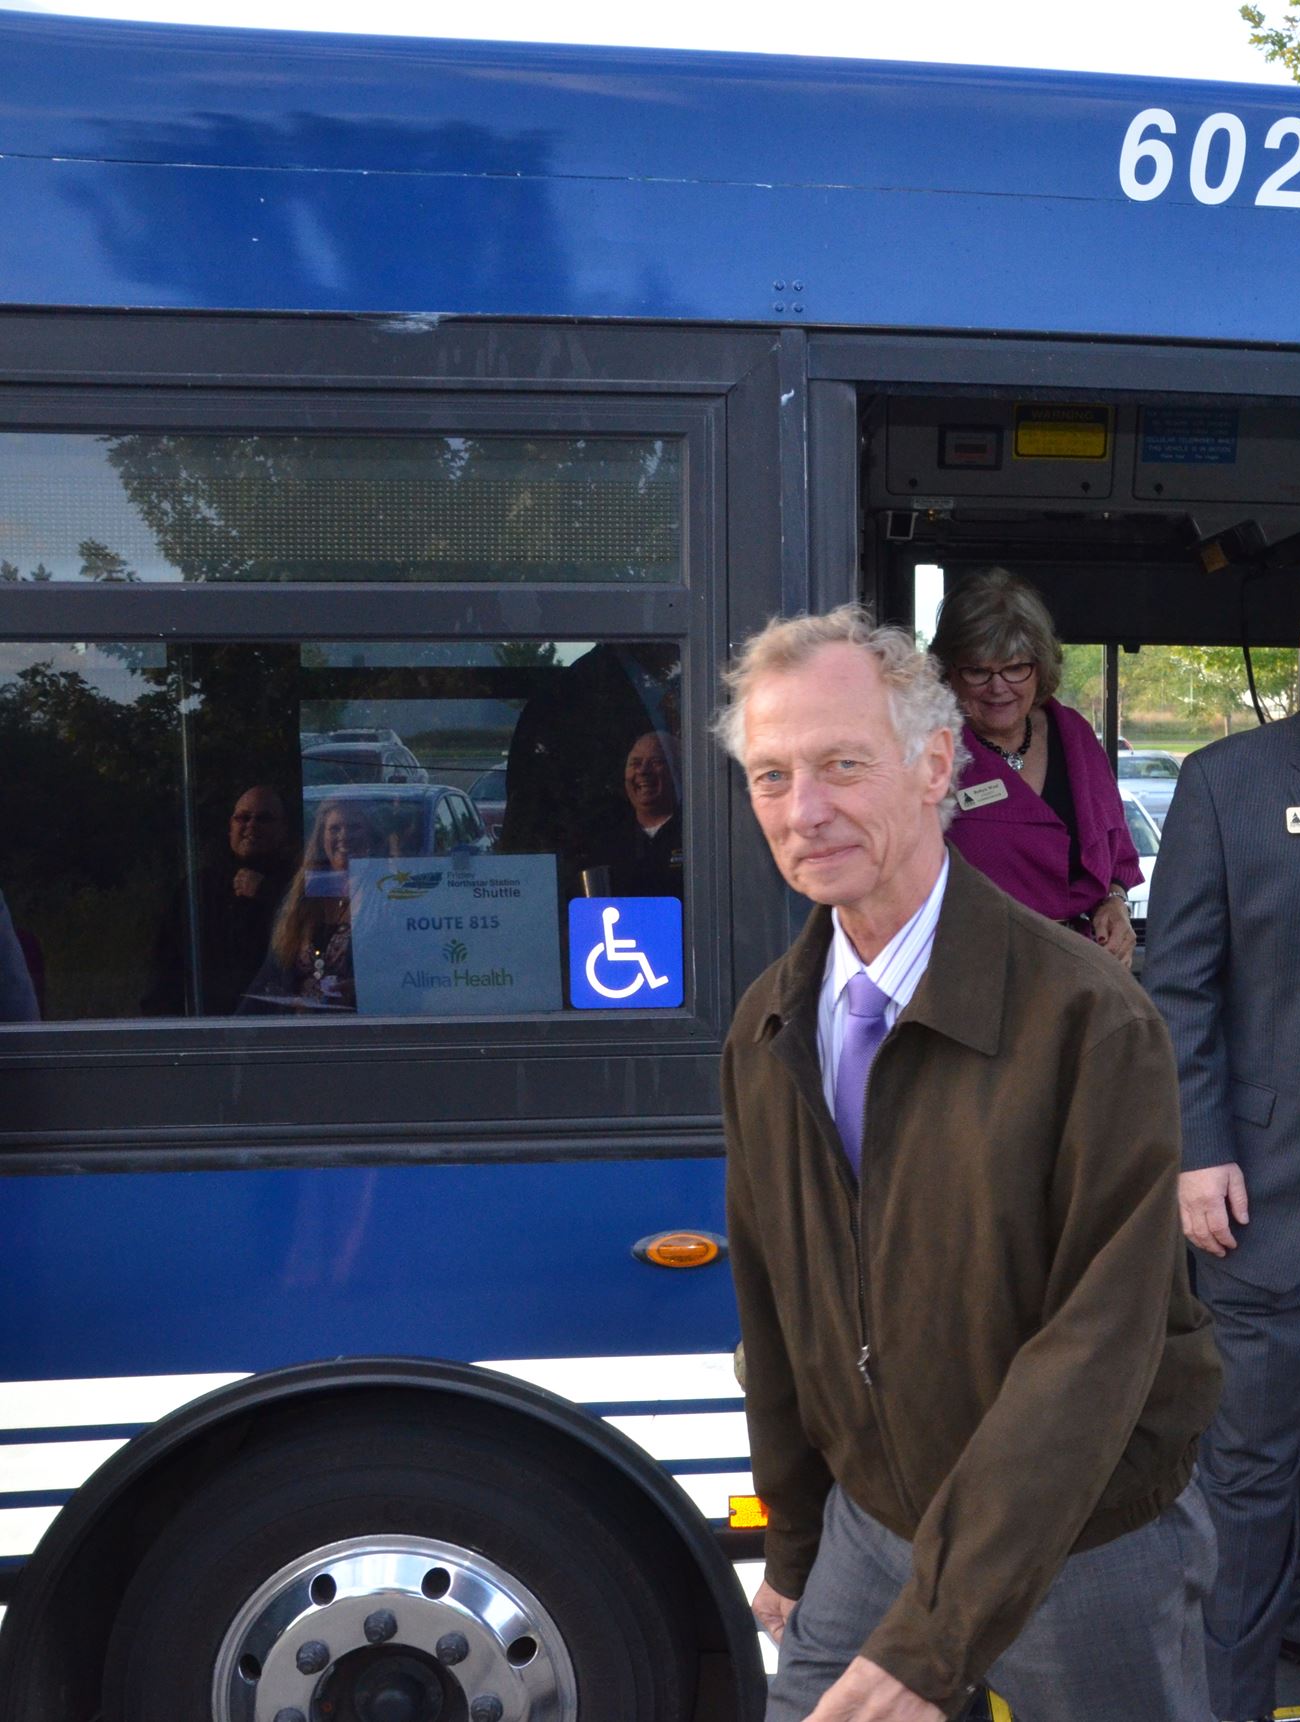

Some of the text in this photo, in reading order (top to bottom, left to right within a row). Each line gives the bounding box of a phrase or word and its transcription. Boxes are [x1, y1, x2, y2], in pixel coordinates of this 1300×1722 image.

[447, 878, 521, 888] Northstar Station
[473, 886, 521, 899] Shuttle
[406, 915, 500, 931] ROUTE 815
[401, 967, 514, 989] Allina Health
